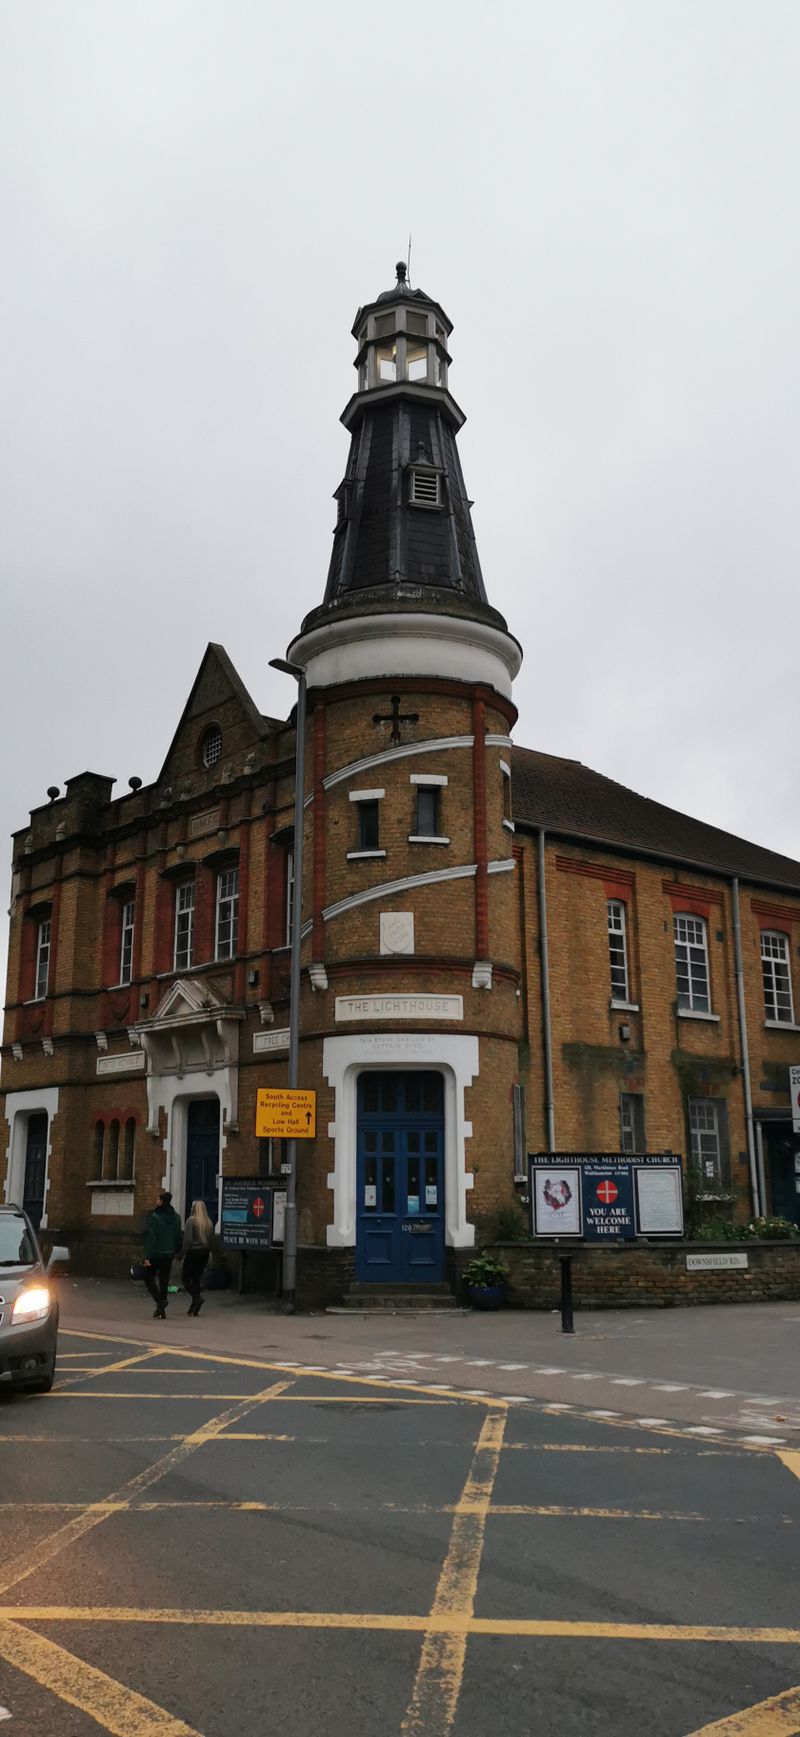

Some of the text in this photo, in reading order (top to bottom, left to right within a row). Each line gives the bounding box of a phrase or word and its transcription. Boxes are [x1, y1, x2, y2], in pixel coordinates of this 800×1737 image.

[348, 1000, 449, 1013] THE LIGHTHOUSE
[260, 1101, 290, 1109] Recycling
[263, 1126, 284, 1134] Sports
[551, 1156, 600, 1164] LIGHTHOUSE
[601, 1156, 645, 1164] METHODIST
[589, 1208, 627, 1216] YOU ARE
[586, 1217, 632, 1225] WELCOME
[596, 1226, 621, 1234] HERE
[688, 1257, 729, 1266] DOWNSFIELD
